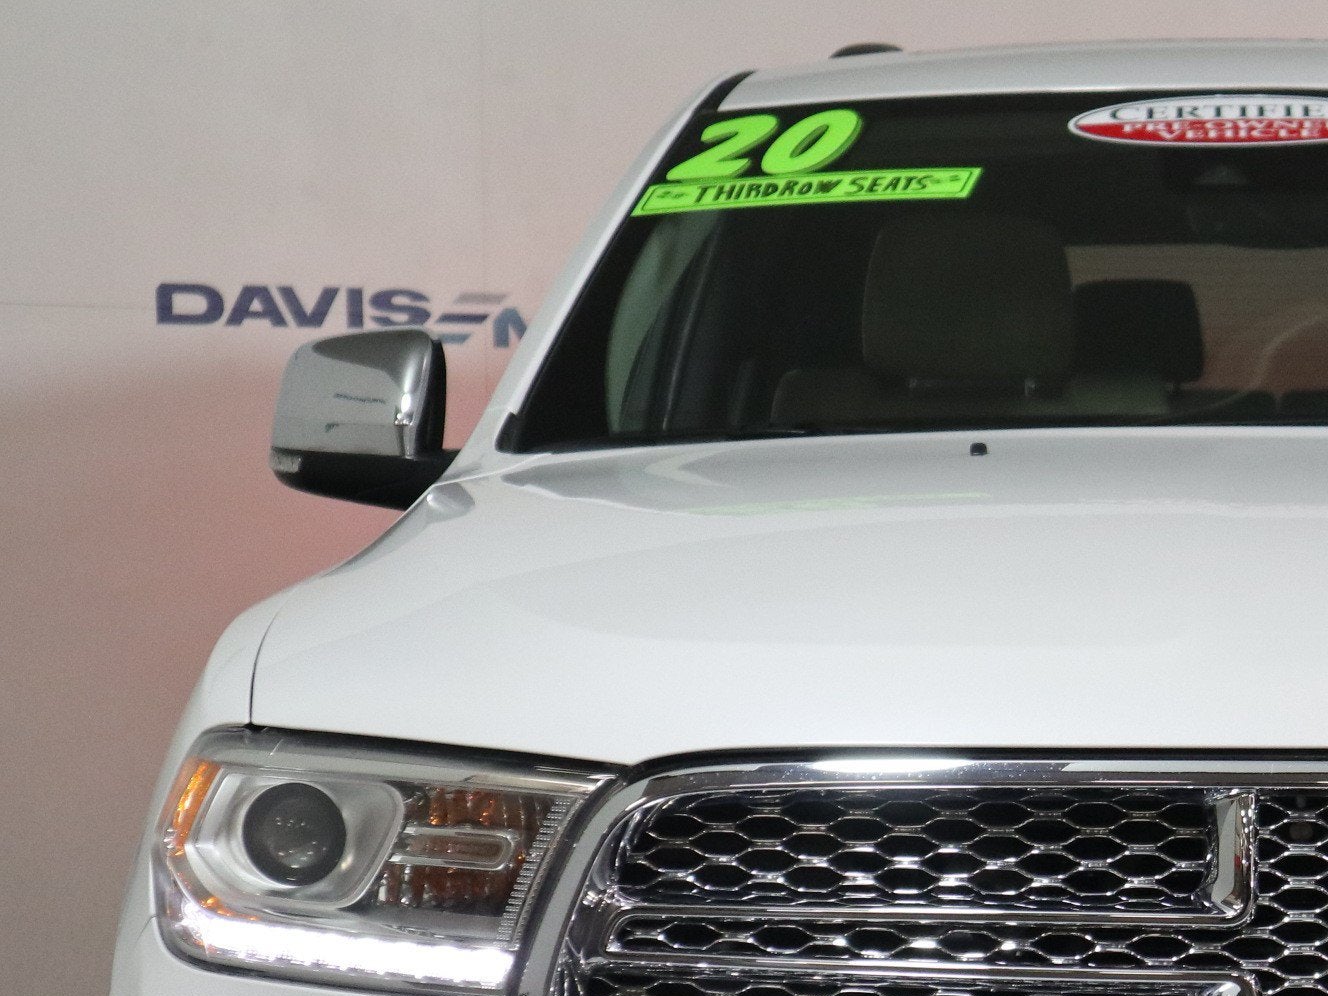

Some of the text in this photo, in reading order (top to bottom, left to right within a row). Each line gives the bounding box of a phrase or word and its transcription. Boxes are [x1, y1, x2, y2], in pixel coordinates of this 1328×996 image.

[666, 109, 862, 182] 20
[1157, 128, 1321, 141] VEHICLE
[845, 174, 932, 195] SEATS
[155, 282, 432, 328] DAVIS
